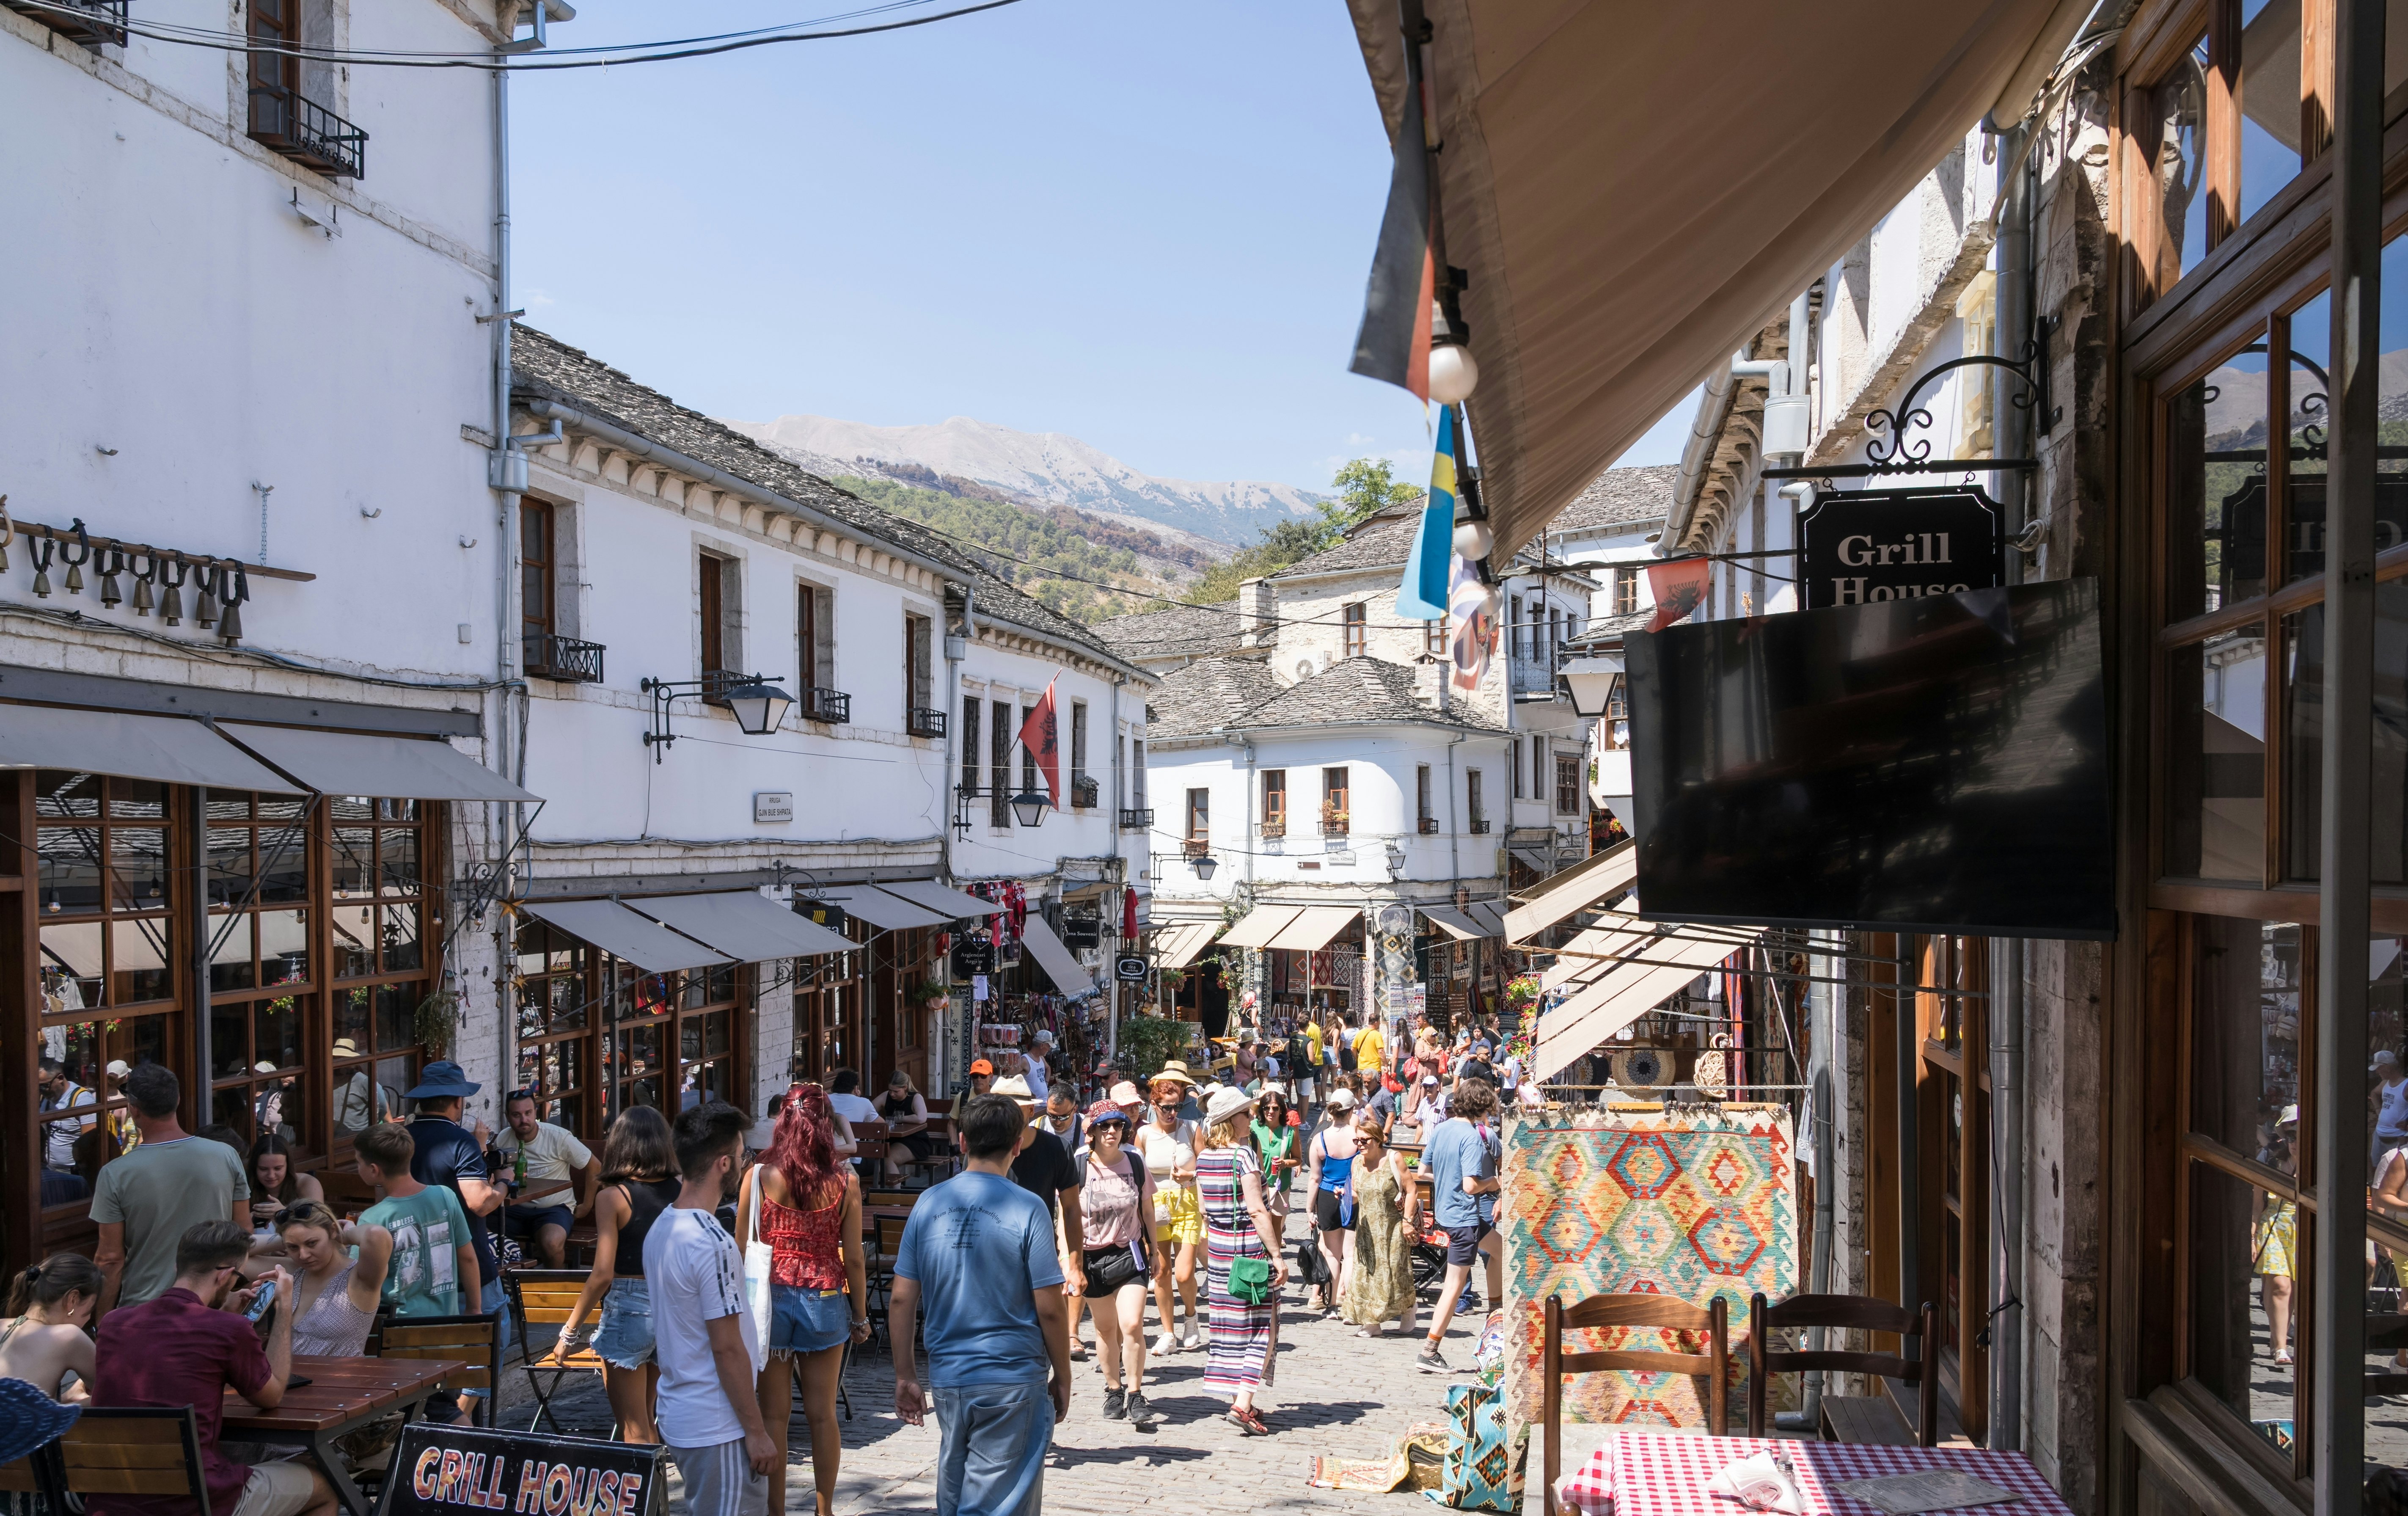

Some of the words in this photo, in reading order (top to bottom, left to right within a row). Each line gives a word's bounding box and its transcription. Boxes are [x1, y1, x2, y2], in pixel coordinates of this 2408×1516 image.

[1838, 532, 1952, 566] Grill
[388, 1215, 414, 1229] ENDLESS
[933, 1210, 947, 1222] From
[948, 1206, 969, 1216] Nothing
[978, 1206, 1002, 1224] Something
[414, 1447, 507, 1510] GRILL
[515, 1460, 642, 1516] HOUSE
